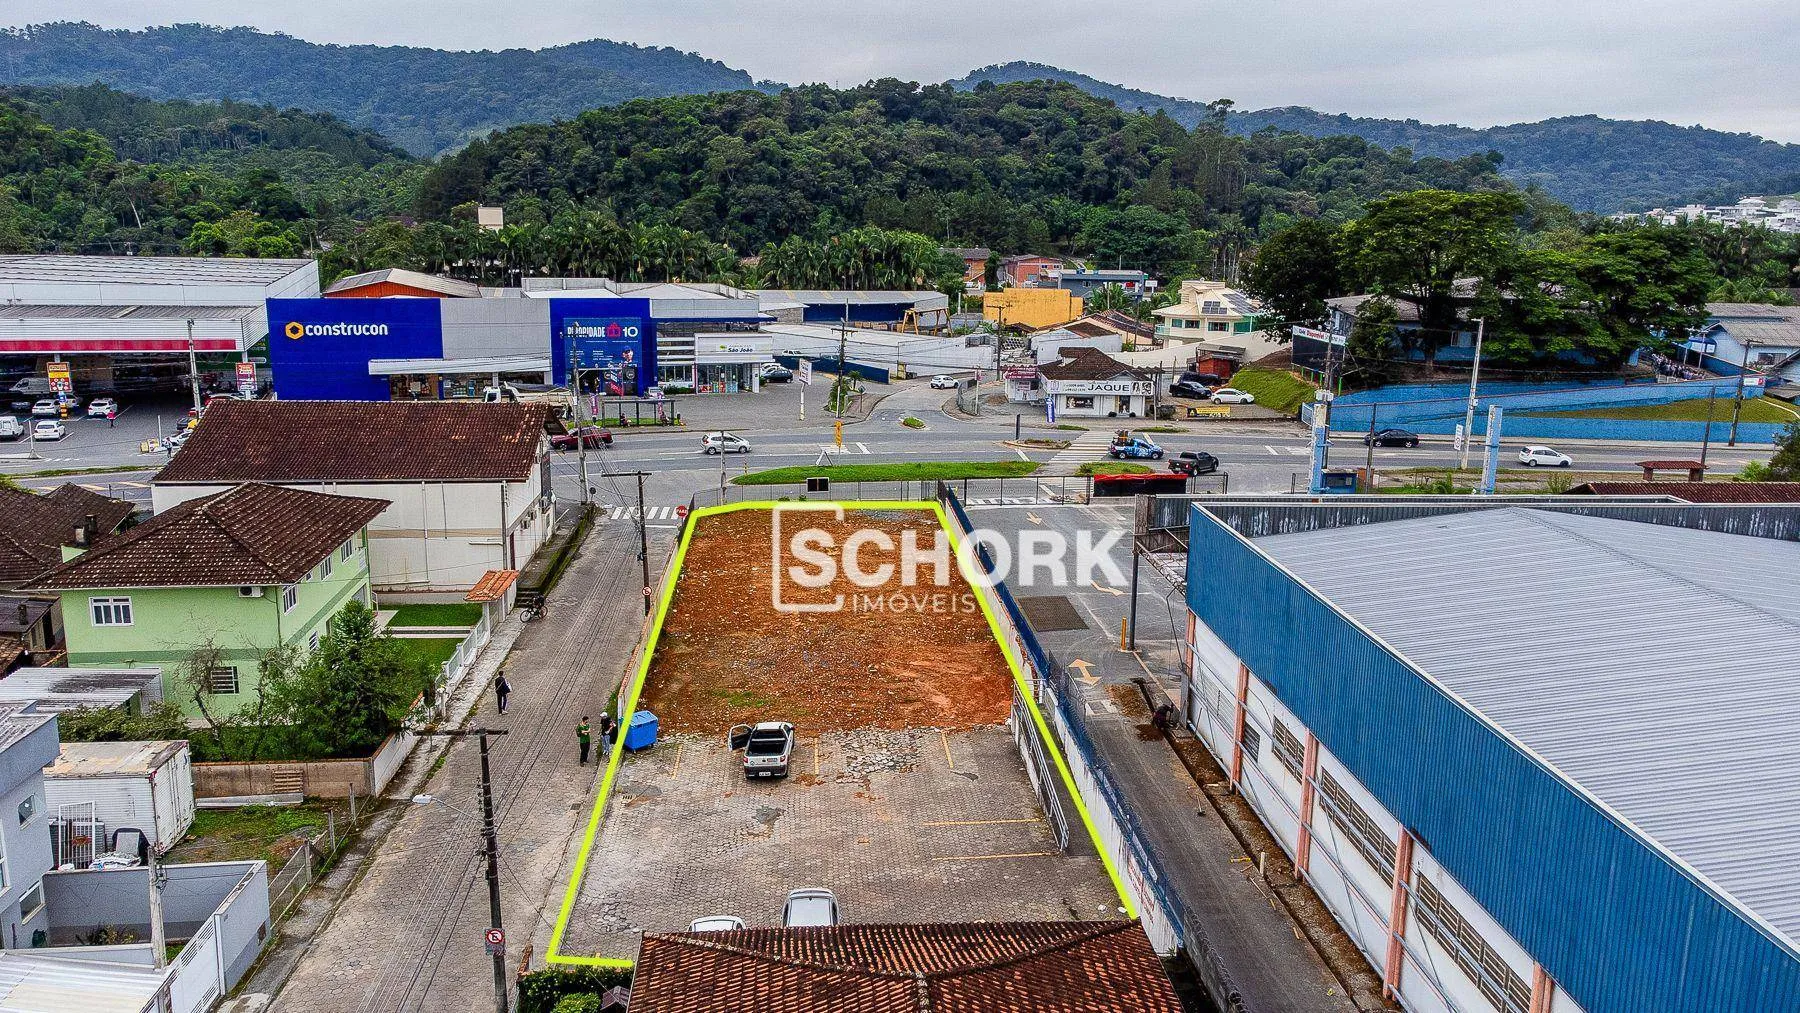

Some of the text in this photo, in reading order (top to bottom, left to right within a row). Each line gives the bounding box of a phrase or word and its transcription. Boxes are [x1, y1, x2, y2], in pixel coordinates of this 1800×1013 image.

[305, 322, 388, 336] construcon
[622, 326, 639, 338] 10
[1087, 384, 1130, 392] JAQUE
